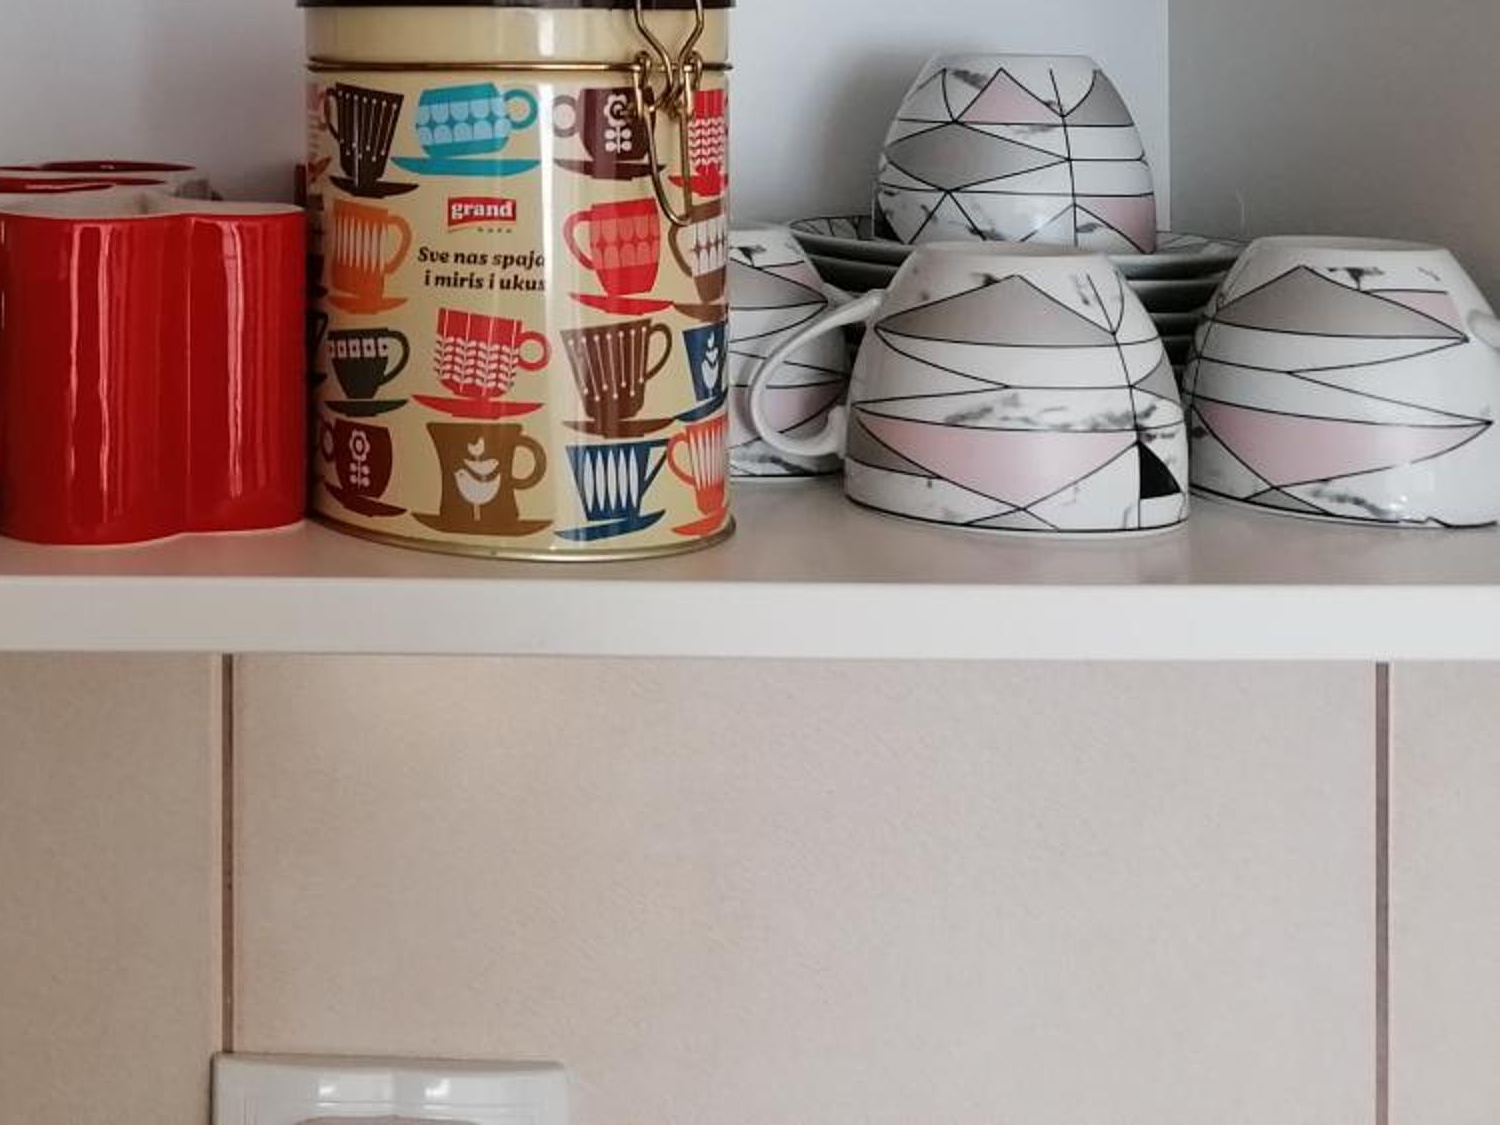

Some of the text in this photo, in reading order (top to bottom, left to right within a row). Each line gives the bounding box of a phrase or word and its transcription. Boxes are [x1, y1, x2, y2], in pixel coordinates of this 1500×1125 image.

[451, 201, 513, 219] grand
[417, 246, 545, 270] Sve nas spaja
[424, 270, 545, 291] i miris i ukus
